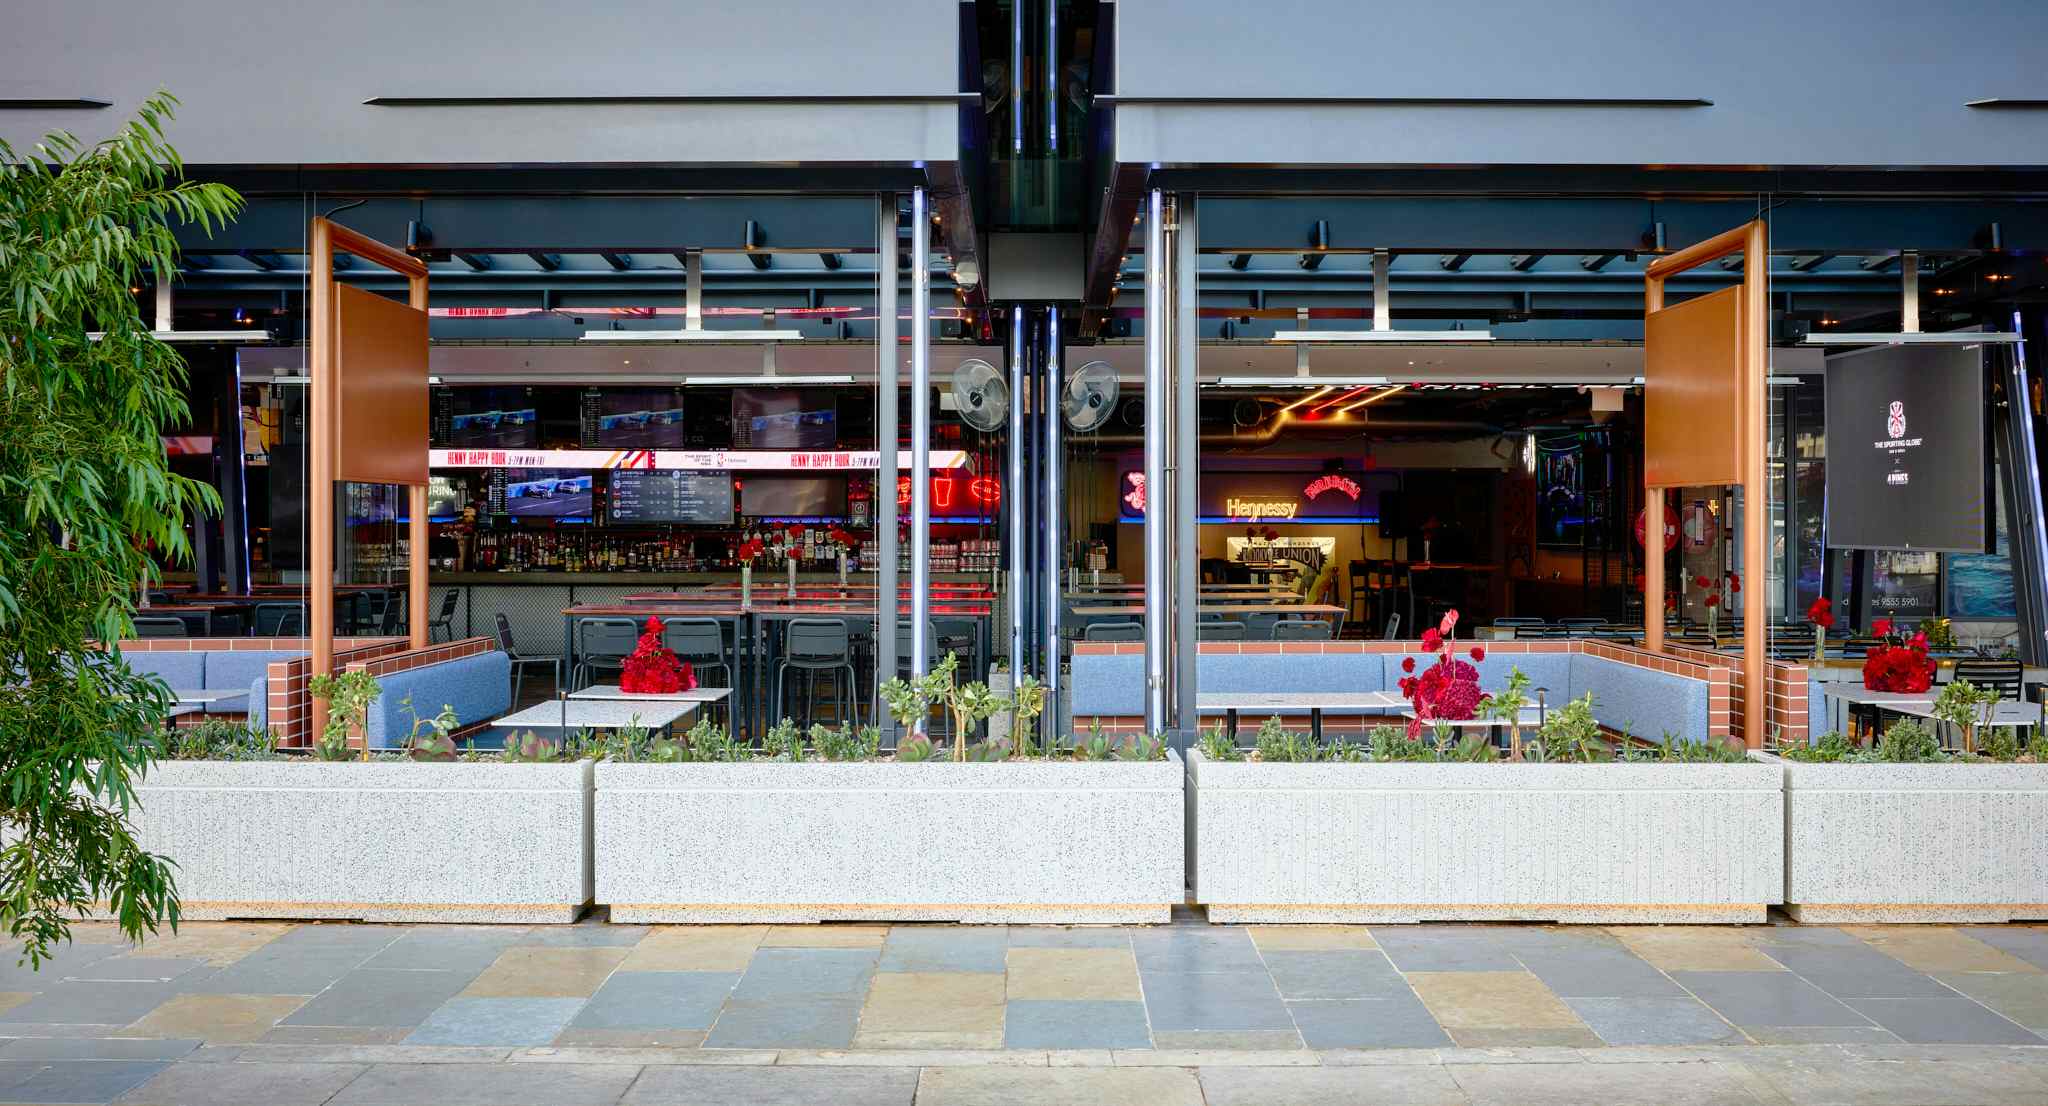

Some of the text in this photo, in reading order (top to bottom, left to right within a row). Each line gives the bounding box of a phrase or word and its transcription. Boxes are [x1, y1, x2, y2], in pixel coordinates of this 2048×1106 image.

[447, 451, 466, 465] HENNY
[469, 451, 489, 465] HAPPY
[491, 451, 506, 465] HOUR
[791, 453, 809, 467] HENNY
[812, 453, 832, 467] HAPPY
[834, 453, 849, 467] HOUR
[1227, 498, 1298, 522] Hennessy
[1283, 548, 1320, 570] UNION
